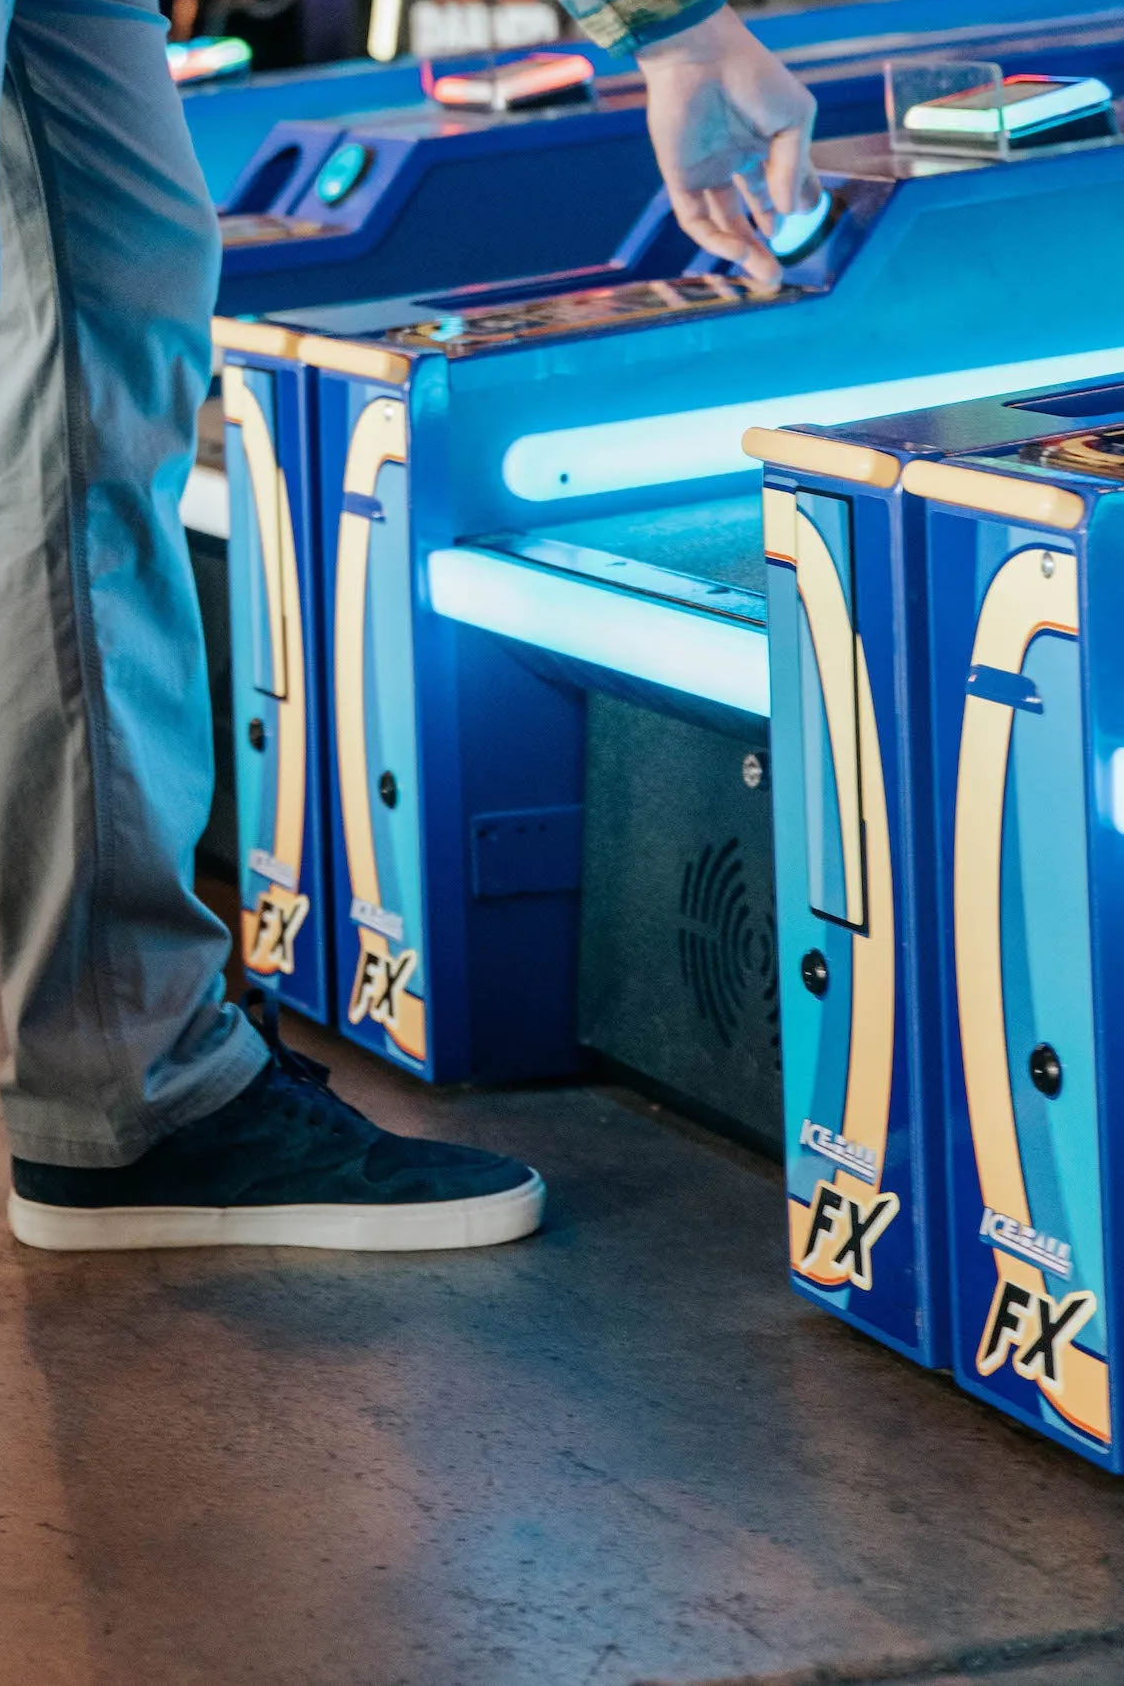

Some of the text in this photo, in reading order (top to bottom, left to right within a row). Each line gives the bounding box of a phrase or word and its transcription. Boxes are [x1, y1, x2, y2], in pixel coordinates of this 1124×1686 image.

[250, 896, 307, 970] FX
[353, 950, 415, 1022] FX
[802, 1183, 896, 1284] FX
[980, 1279, 1093, 1387] FX
